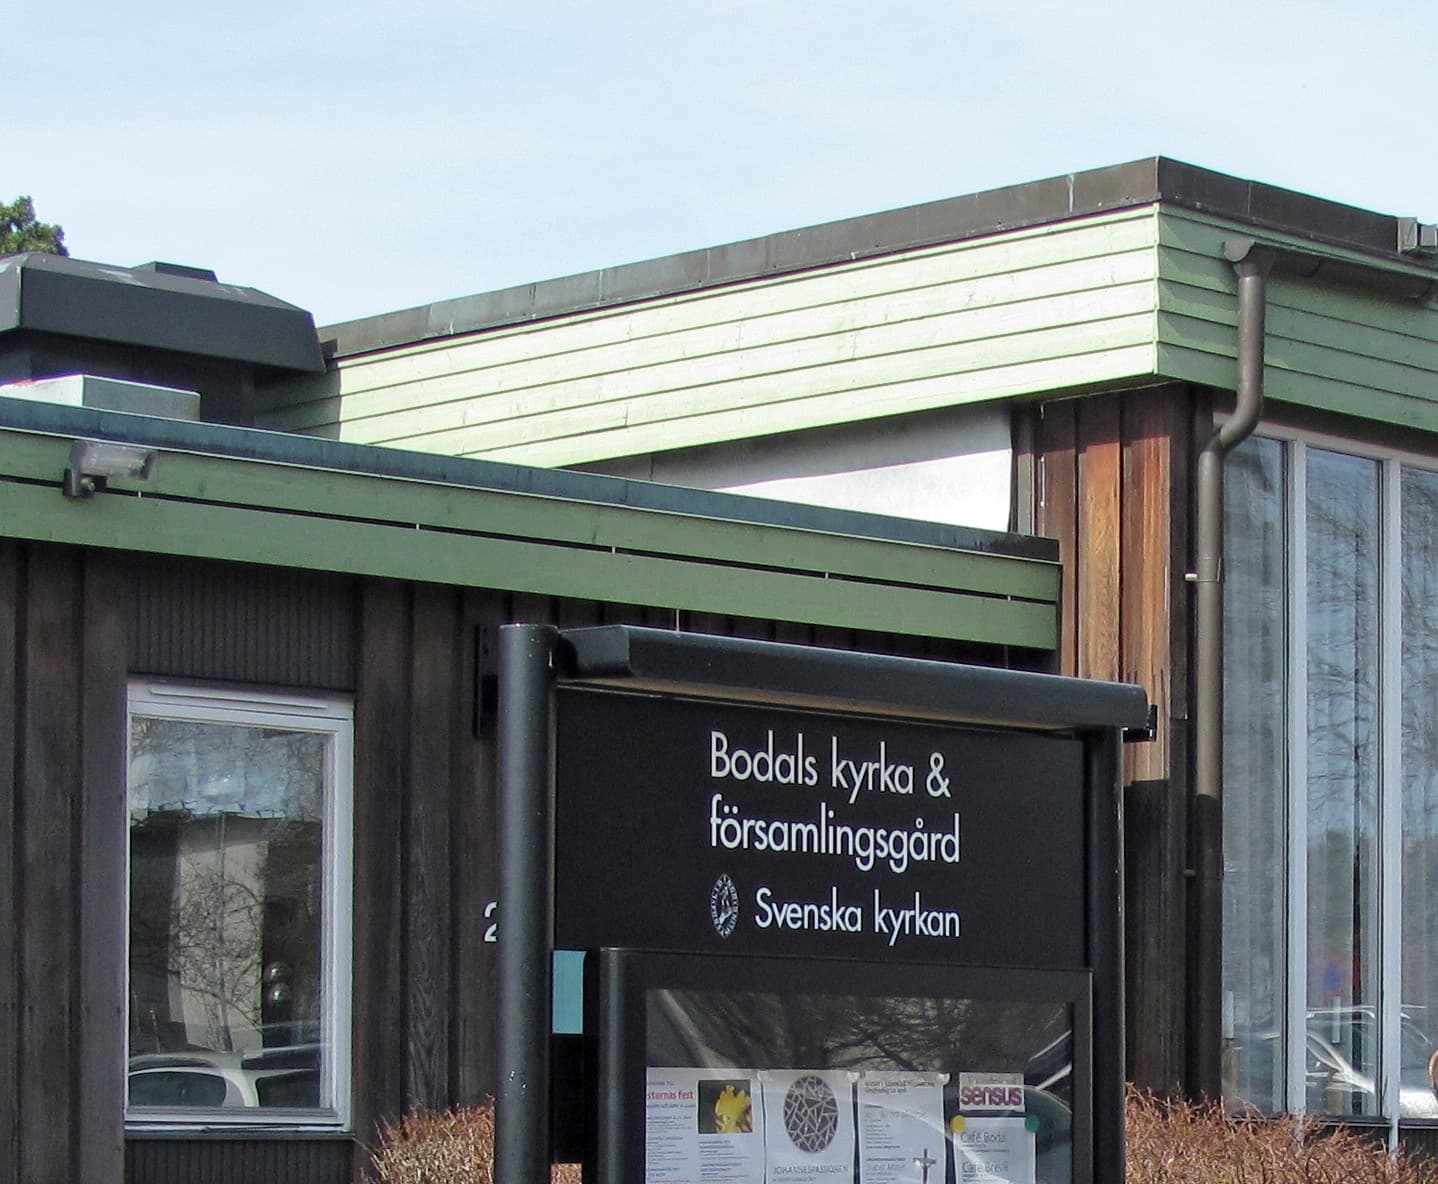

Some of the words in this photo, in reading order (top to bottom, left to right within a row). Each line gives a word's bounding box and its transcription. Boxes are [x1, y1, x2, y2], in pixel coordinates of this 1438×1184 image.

[710, 729, 819, 787] Bodals
[831, 735, 914, 804] kyrka
[926, 752, 952, 798] &
[709, 793, 961, 874] församlingsgård
[754, 886, 862, 933] Svenska
[874, 888, 960, 947] kyrkan
[960, 1086, 1022, 1106] sensus
